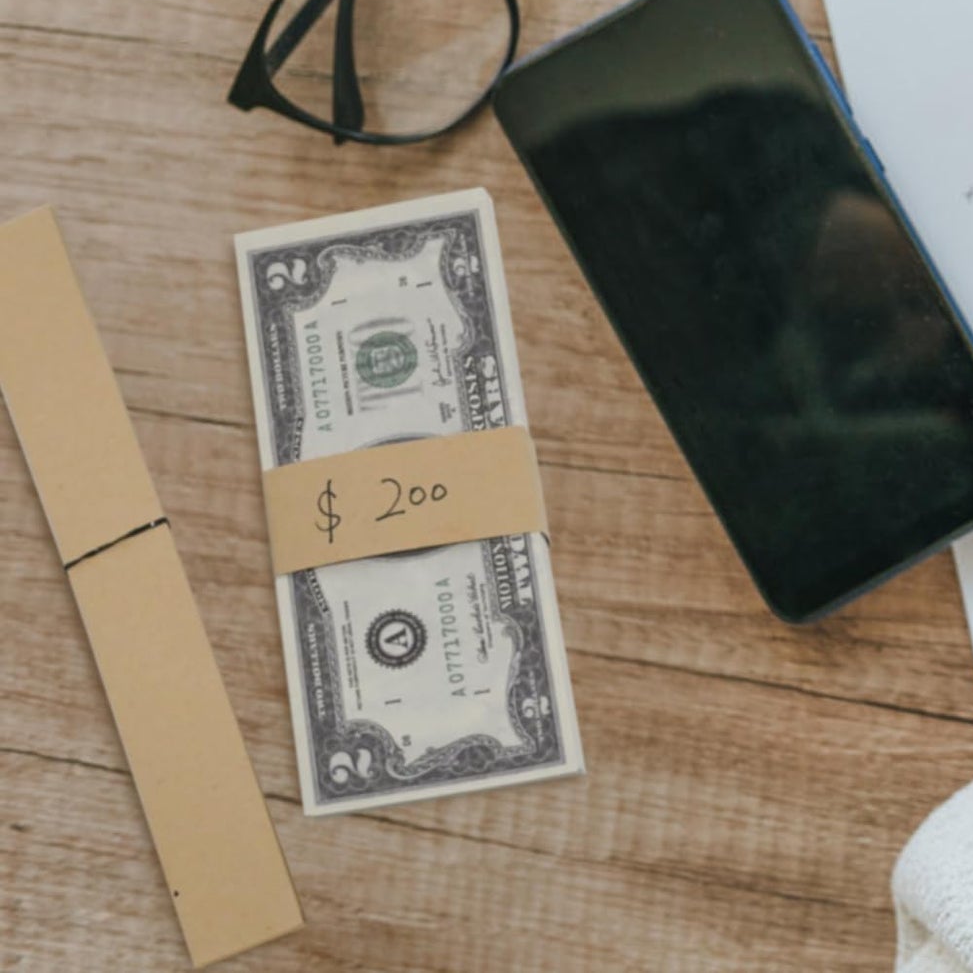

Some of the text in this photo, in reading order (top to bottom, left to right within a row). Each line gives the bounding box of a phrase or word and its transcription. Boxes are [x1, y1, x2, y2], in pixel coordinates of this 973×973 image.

[266, 257, 308, 290] 2
[315, 478, 447, 544] $ 200
[493, 543, 513, 609] MOTION
[383, 628, 409, 649] A
[329, 748, 374, 784] 2
